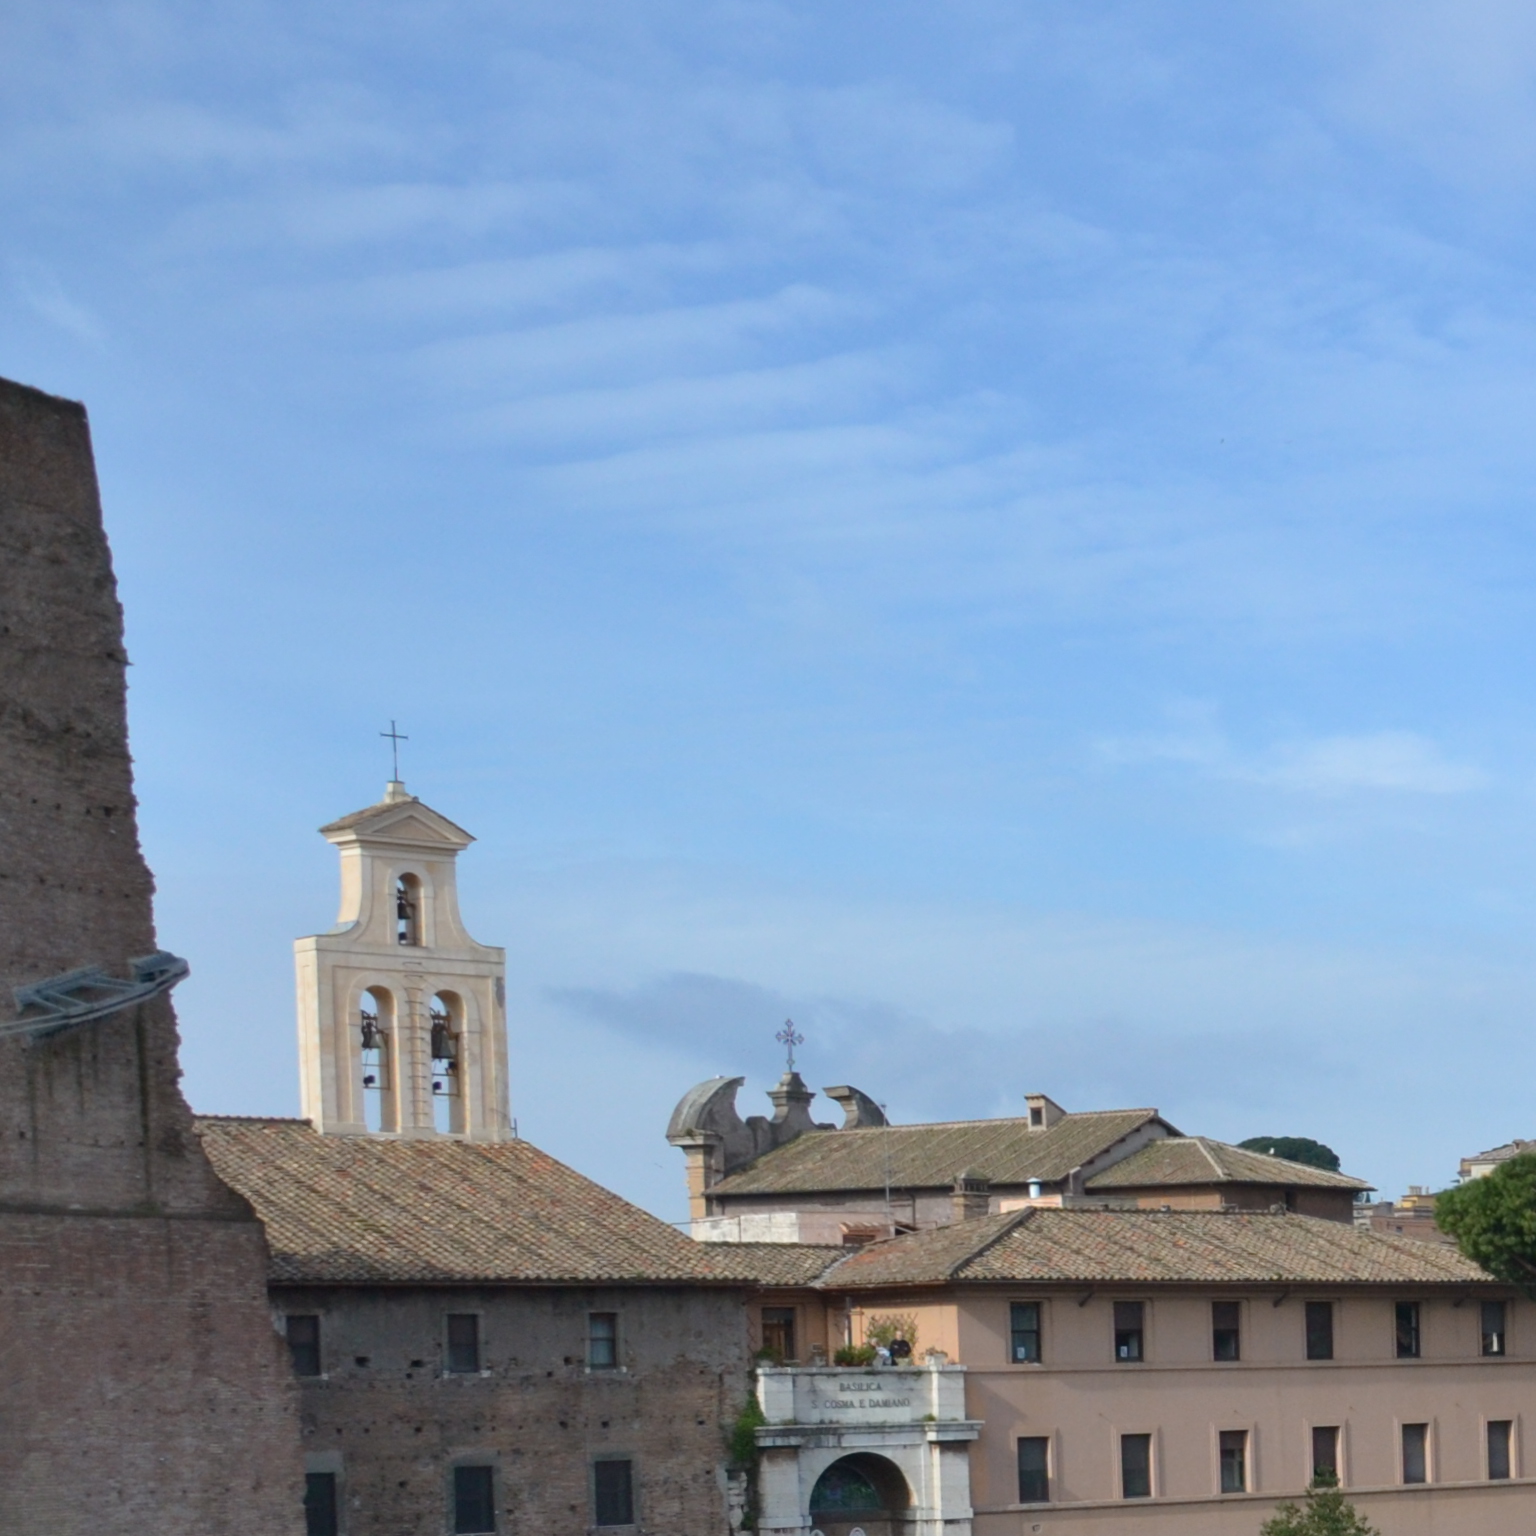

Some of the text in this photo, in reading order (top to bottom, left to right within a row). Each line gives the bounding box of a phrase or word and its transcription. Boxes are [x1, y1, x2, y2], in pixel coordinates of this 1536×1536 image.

[839, 1382, 882, 1392] BASILICA
[824, 1399, 855, 1409] COSMA
[859, 1399, 865, 1408] E
[868, 1398, 910, 1408] DAMIANO
